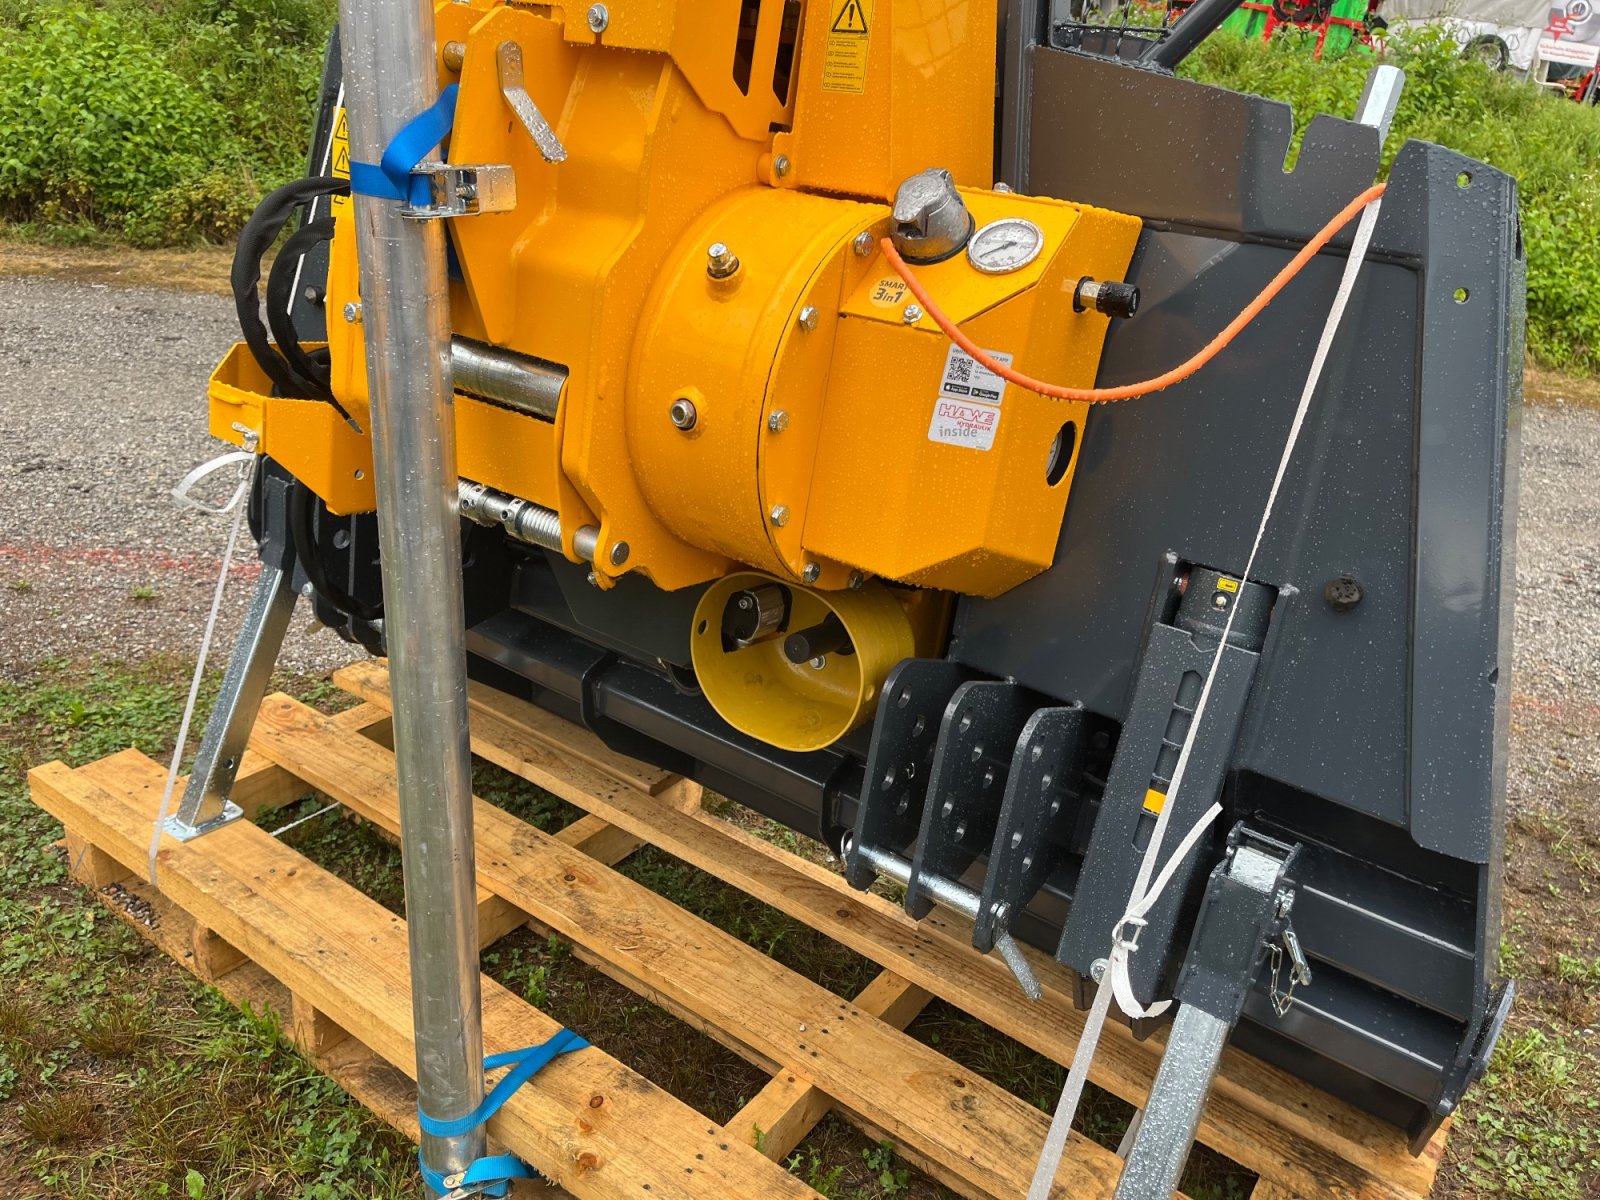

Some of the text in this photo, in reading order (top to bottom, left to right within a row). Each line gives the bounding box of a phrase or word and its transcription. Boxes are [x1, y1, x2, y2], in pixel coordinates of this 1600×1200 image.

[873, 287, 903, 303] 3in1
[938, 403, 996, 426] HAWE
[939, 425, 978, 438] inside
[956, 420, 992, 432] HYDRAULIK
